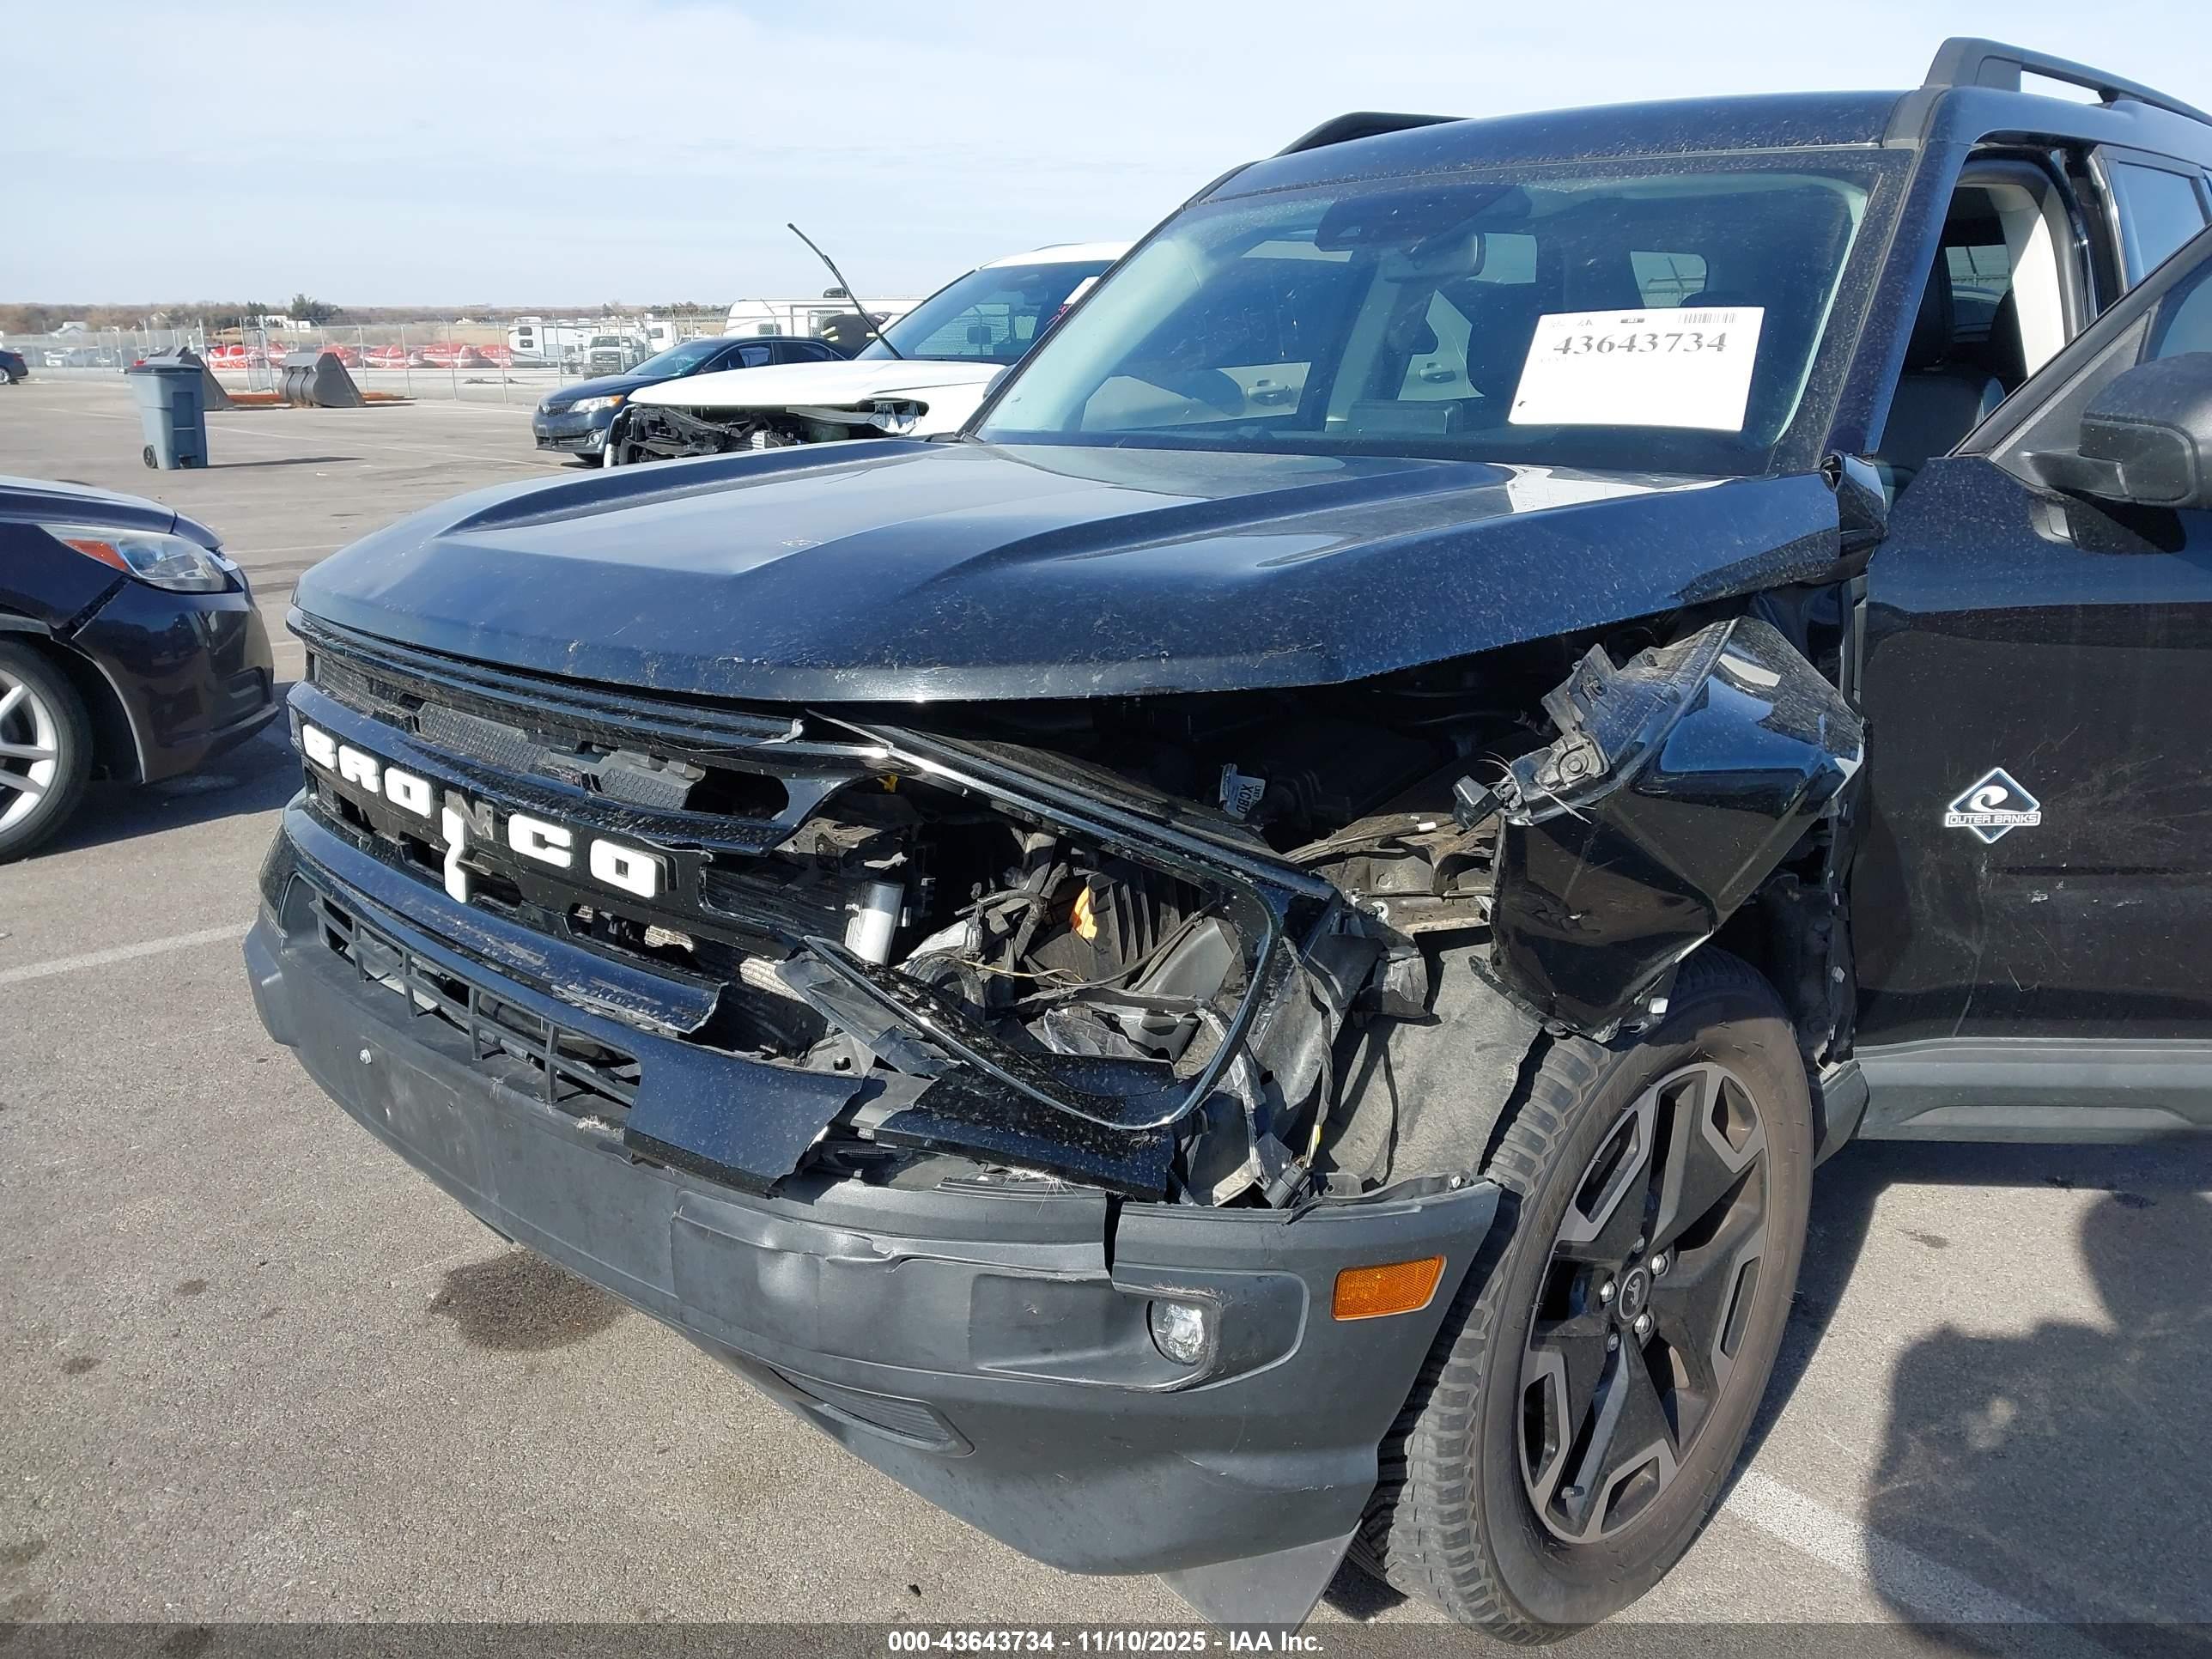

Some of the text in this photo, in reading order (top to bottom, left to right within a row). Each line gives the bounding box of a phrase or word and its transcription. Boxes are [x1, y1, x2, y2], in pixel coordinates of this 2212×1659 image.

[1553, 331, 1728, 356] 43643734
[302, 724, 658, 900] BRONCO
[1237, 782, 1255, 814] XCBD
[1949, 814, 2038, 824] OUTER BANKS
